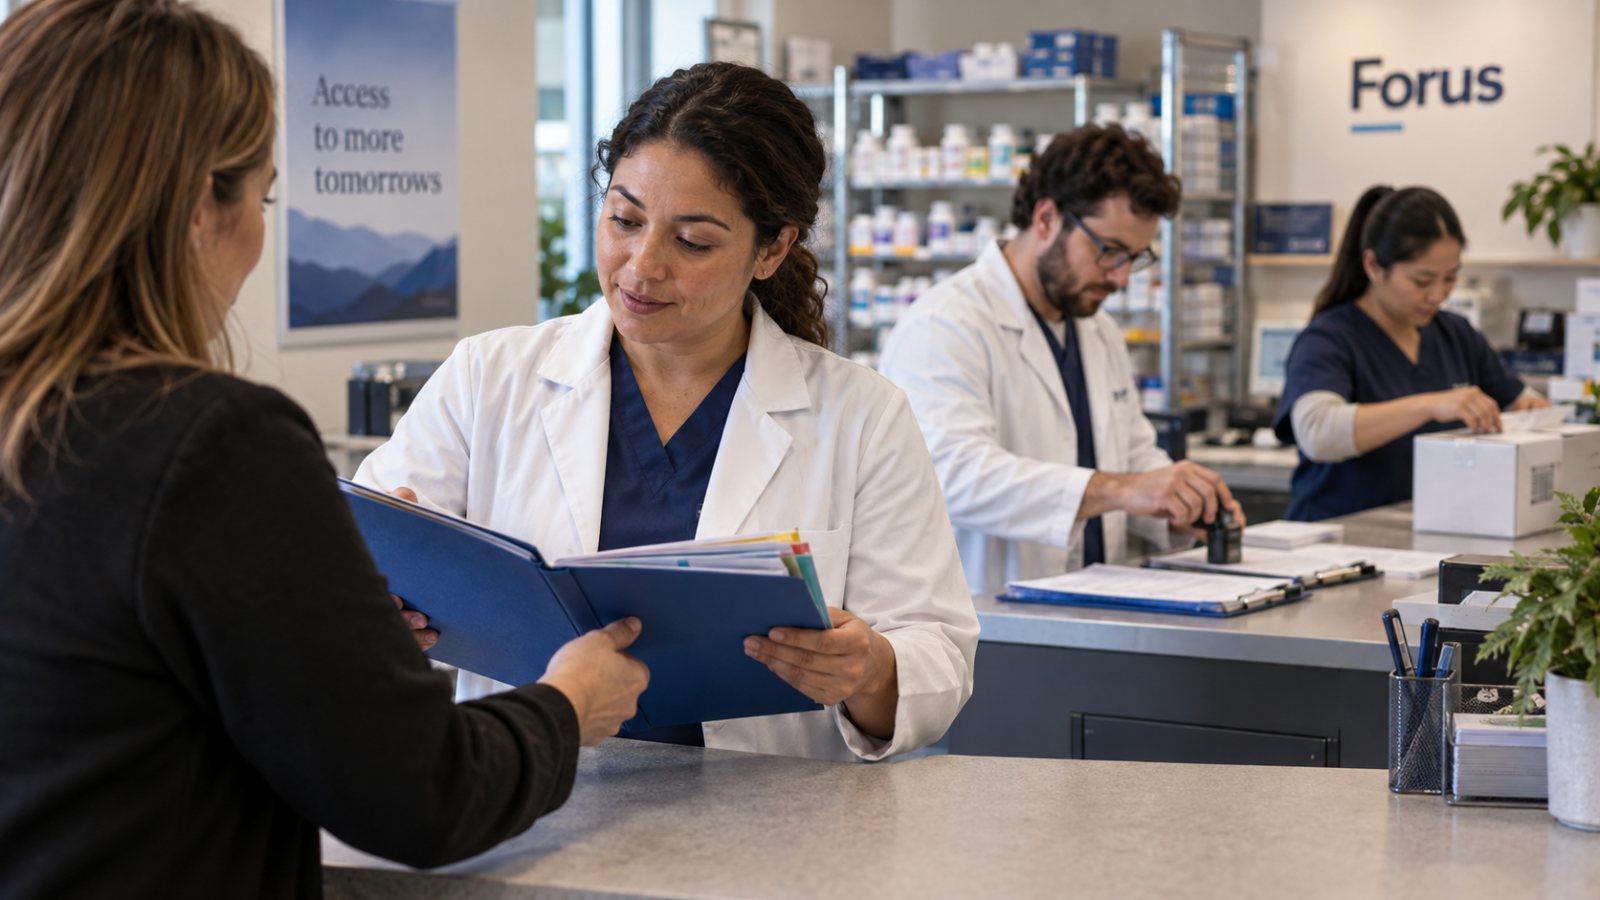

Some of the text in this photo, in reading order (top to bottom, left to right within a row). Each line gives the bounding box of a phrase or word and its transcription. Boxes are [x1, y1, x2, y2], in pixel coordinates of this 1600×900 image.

[313, 75, 390, 109] Access
[1352, 58, 1504, 110] Forus
[315, 122, 404, 153] to more
[315, 167, 442, 194] tomorrows
